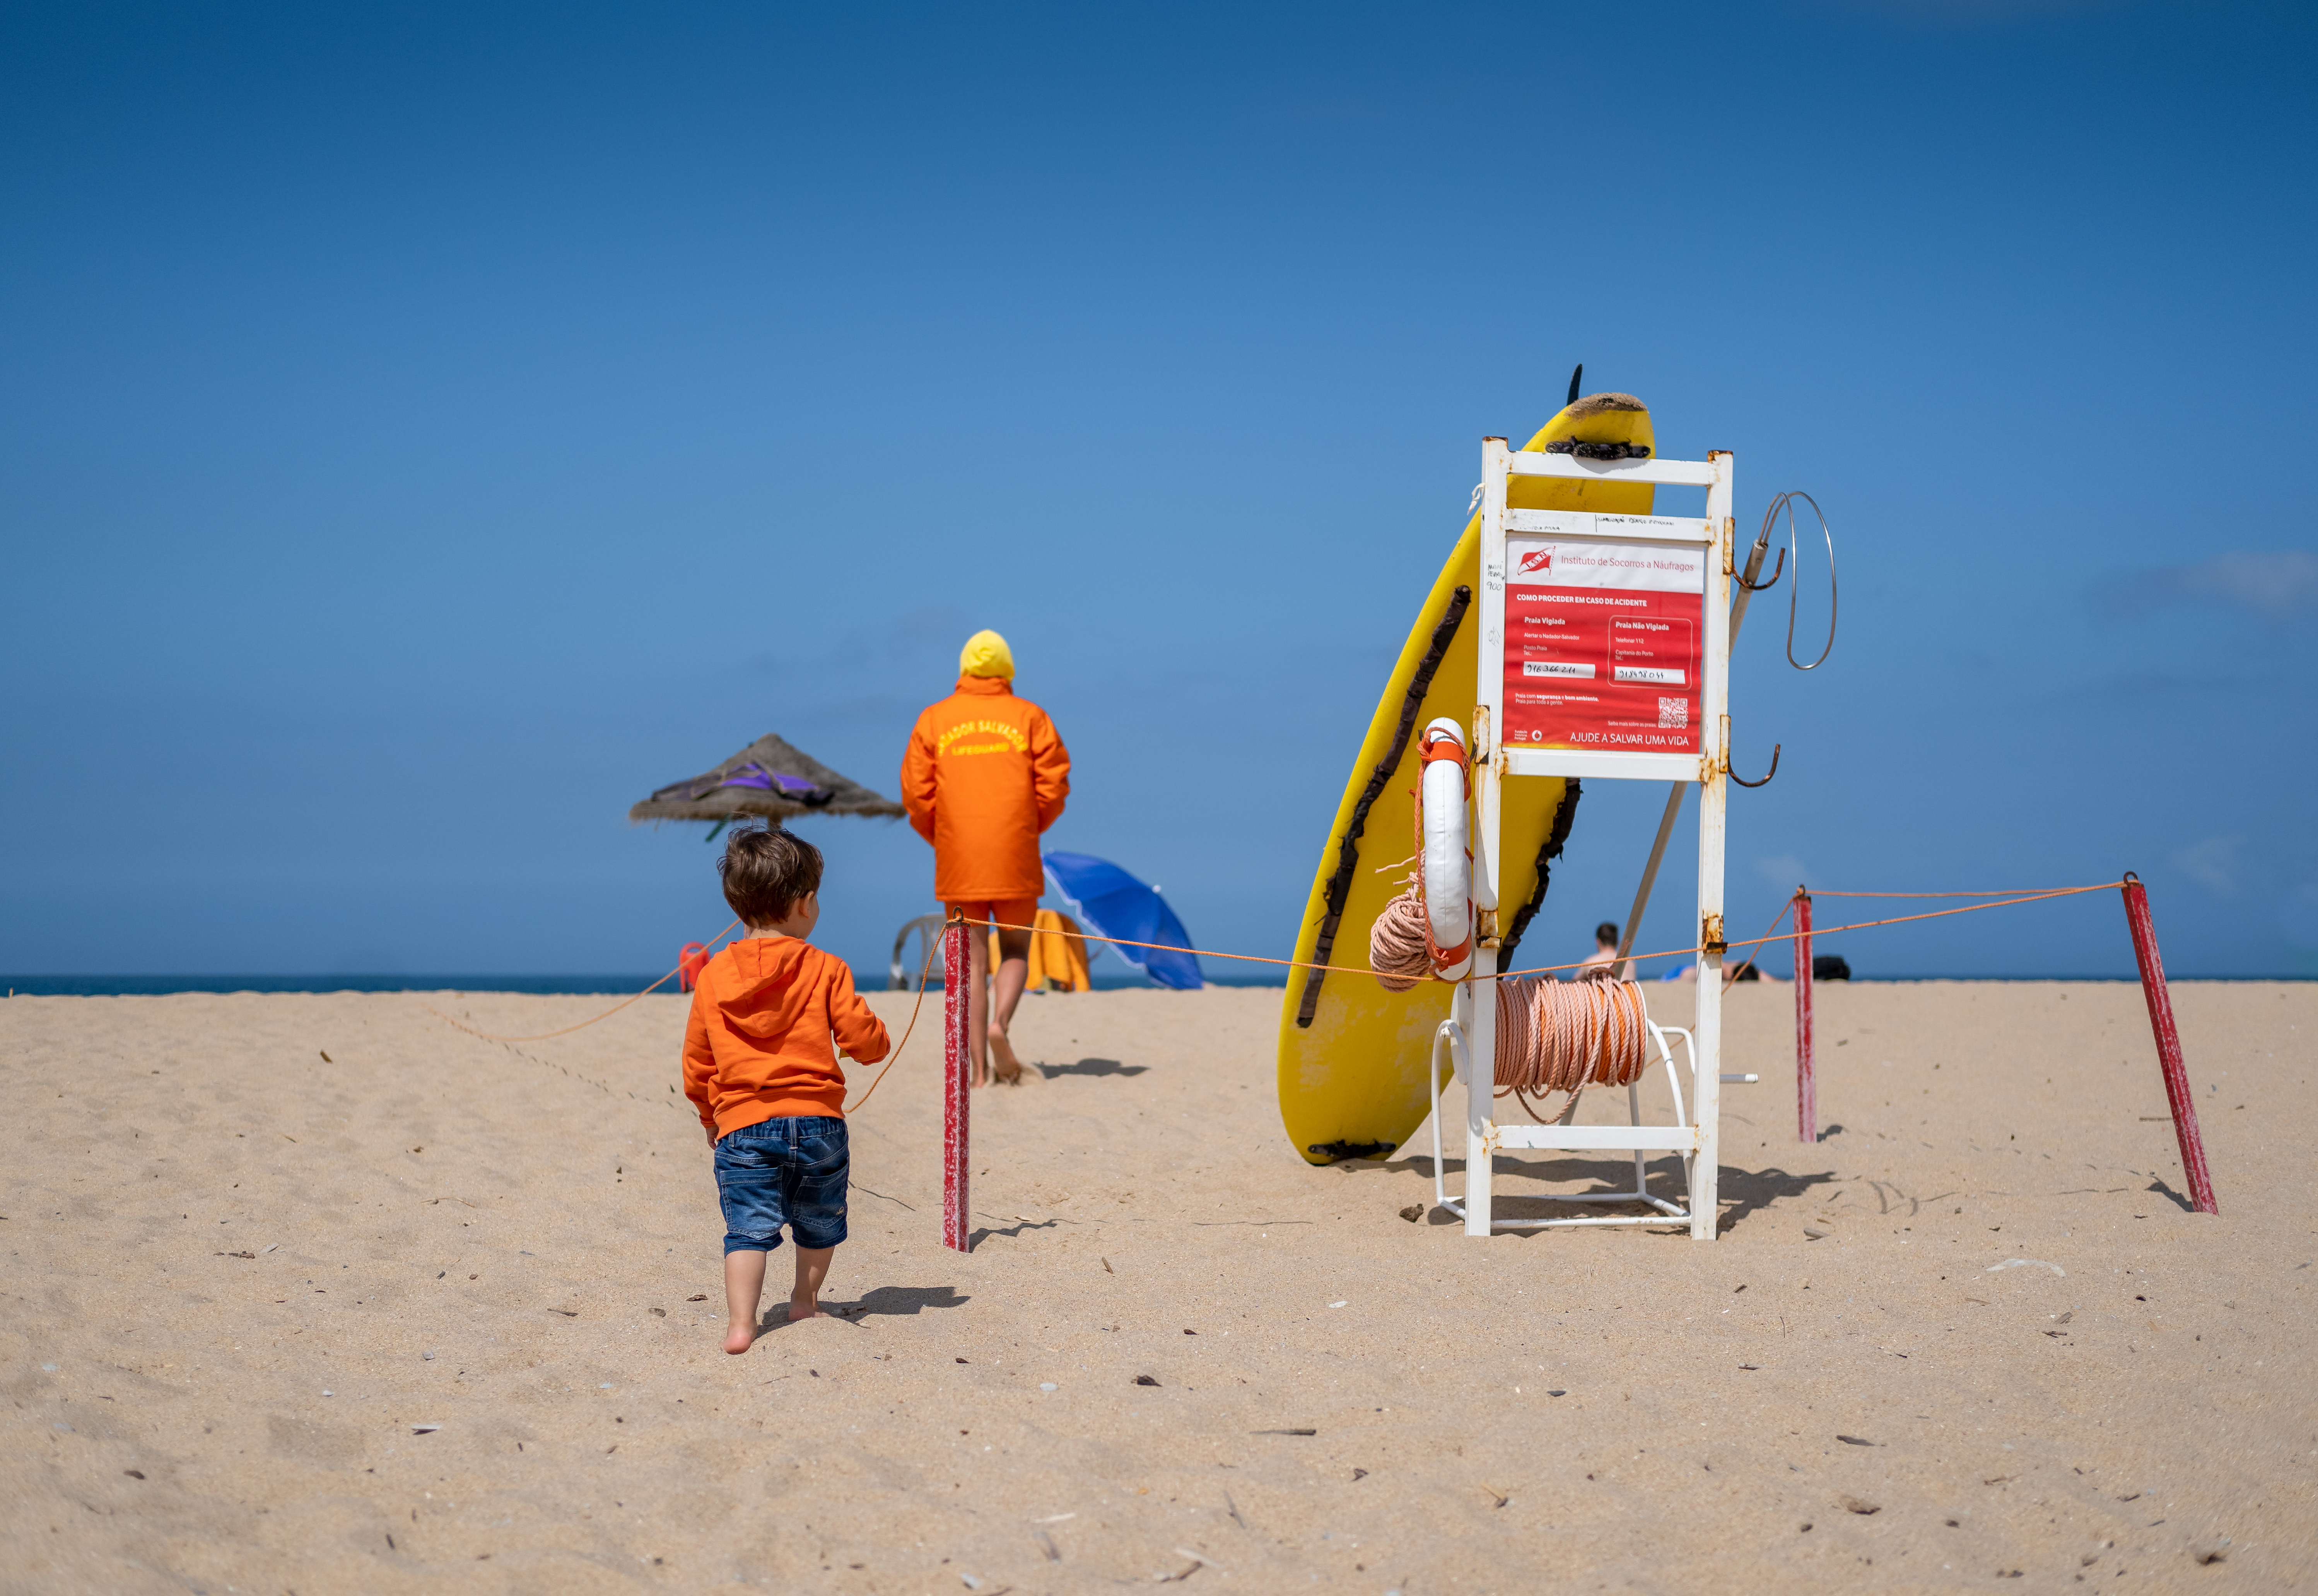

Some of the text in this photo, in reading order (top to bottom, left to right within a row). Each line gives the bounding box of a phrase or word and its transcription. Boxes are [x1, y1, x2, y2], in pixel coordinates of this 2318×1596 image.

[1561, 555, 1595, 565] Instituto
[1598, 557, 1607, 566] de
[1610, 557, 1645, 568] Socorros
[1654, 560, 1694, 573] Náufragos
[1486, 581, 1502, 591] 900
[1538, 595, 1574, 603] PROCEDER
[1614, 598, 1647, 607] ACIDENTE
[1541, 617, 1565, 626] Vigiada
[1646, 623, 1669, 631] Vigiada
[977, 719, 1028, 753] SALVADOR
[1570, 732, 1689, 746] AJUDE A SALVAR UMA VIDA
[951, 742, 1010, 756] LIFEGUARD
